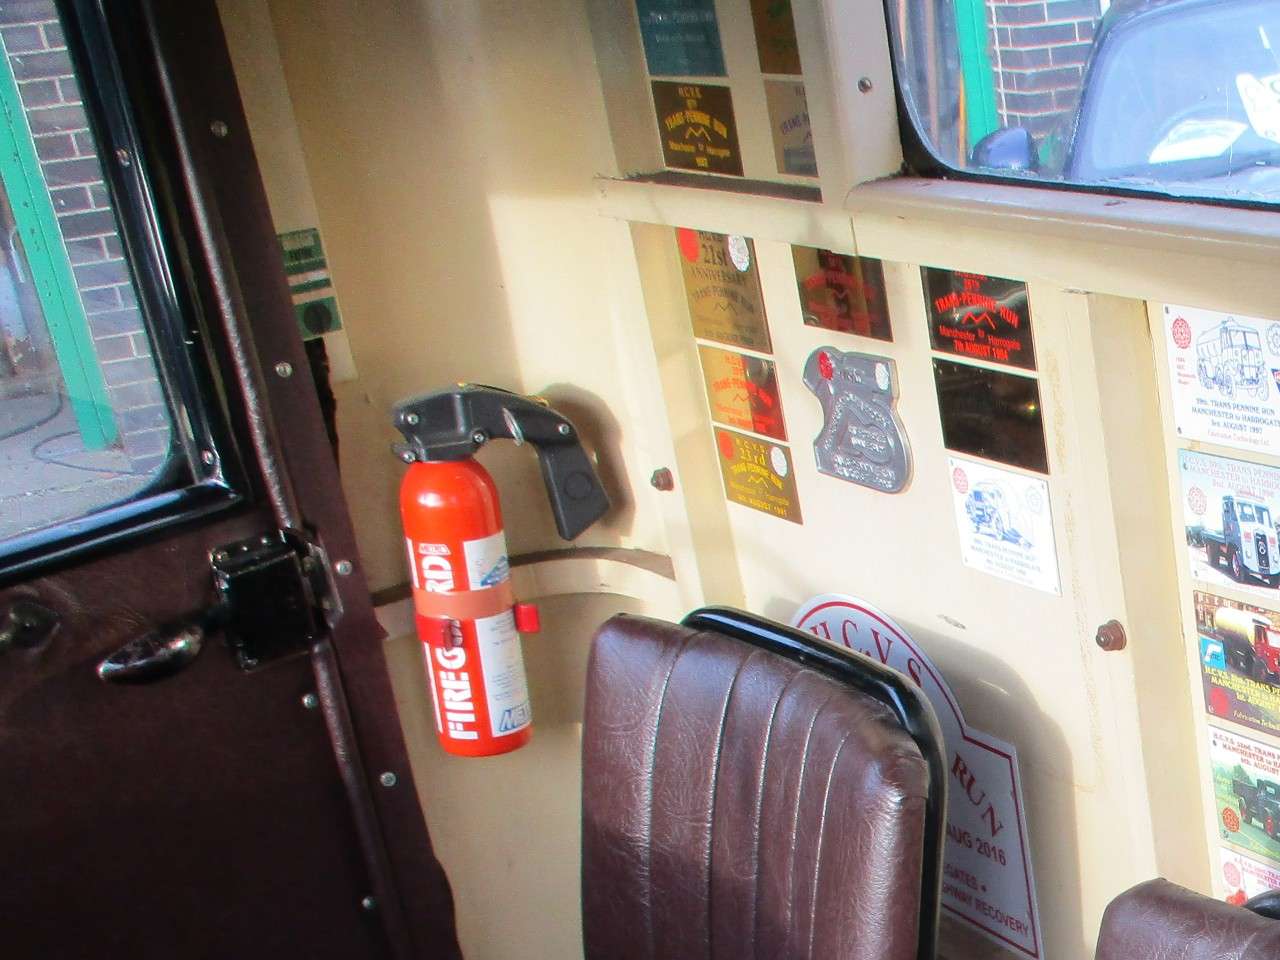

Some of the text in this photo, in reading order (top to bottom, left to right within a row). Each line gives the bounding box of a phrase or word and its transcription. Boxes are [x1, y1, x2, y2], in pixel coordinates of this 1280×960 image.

[1192, 407, 1233, 420] MANCHESTER
[1222, 743, 1265, 763] MANCHESTER
[1254, 746, 1275, 759] TRANS
[1254, 763, 1279, 776] AUGUST
[976, 837, 1006, 867] 2016
[975, 897, 1029, 936] RECOVERY
